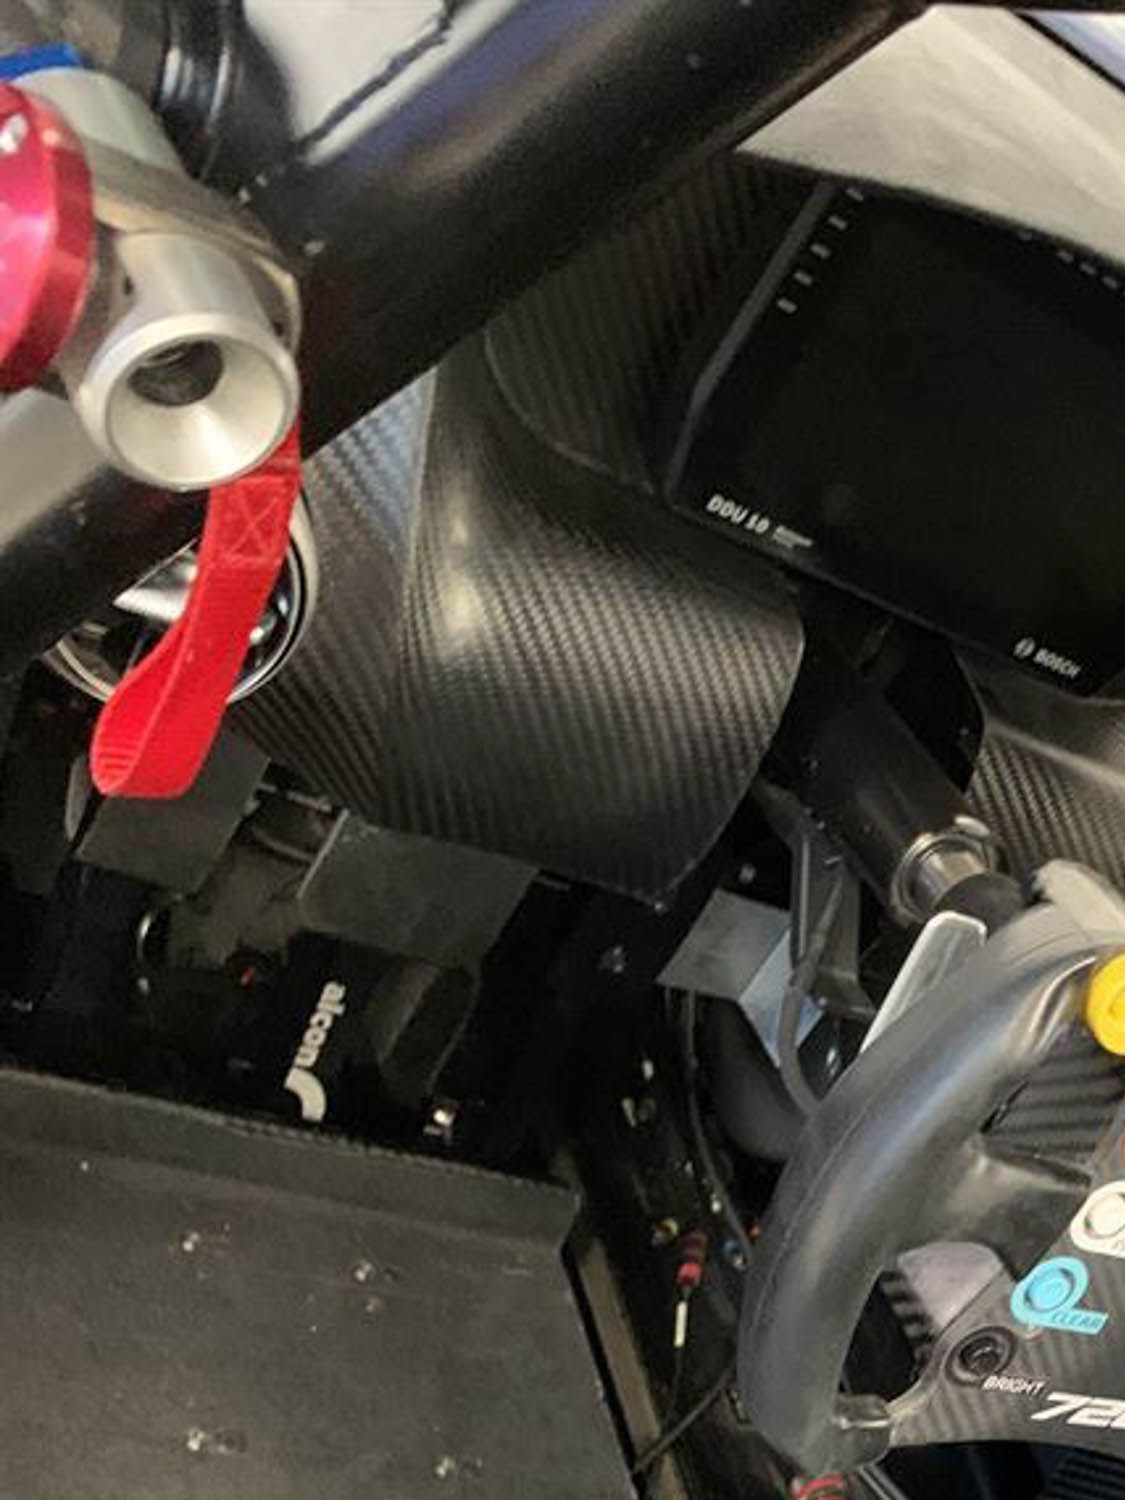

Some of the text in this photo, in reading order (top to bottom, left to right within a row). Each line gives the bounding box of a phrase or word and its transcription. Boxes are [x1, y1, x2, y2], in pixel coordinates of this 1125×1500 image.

[706, 494, 749, 525] DDU
[1033, 648, 1081, 680] BOSCH
[293, 981, 346, 1068] alcon
[1052, 1311, 1104, 1330] CLEAR
[982, 1375, 1047, 1396] BRIGHT
